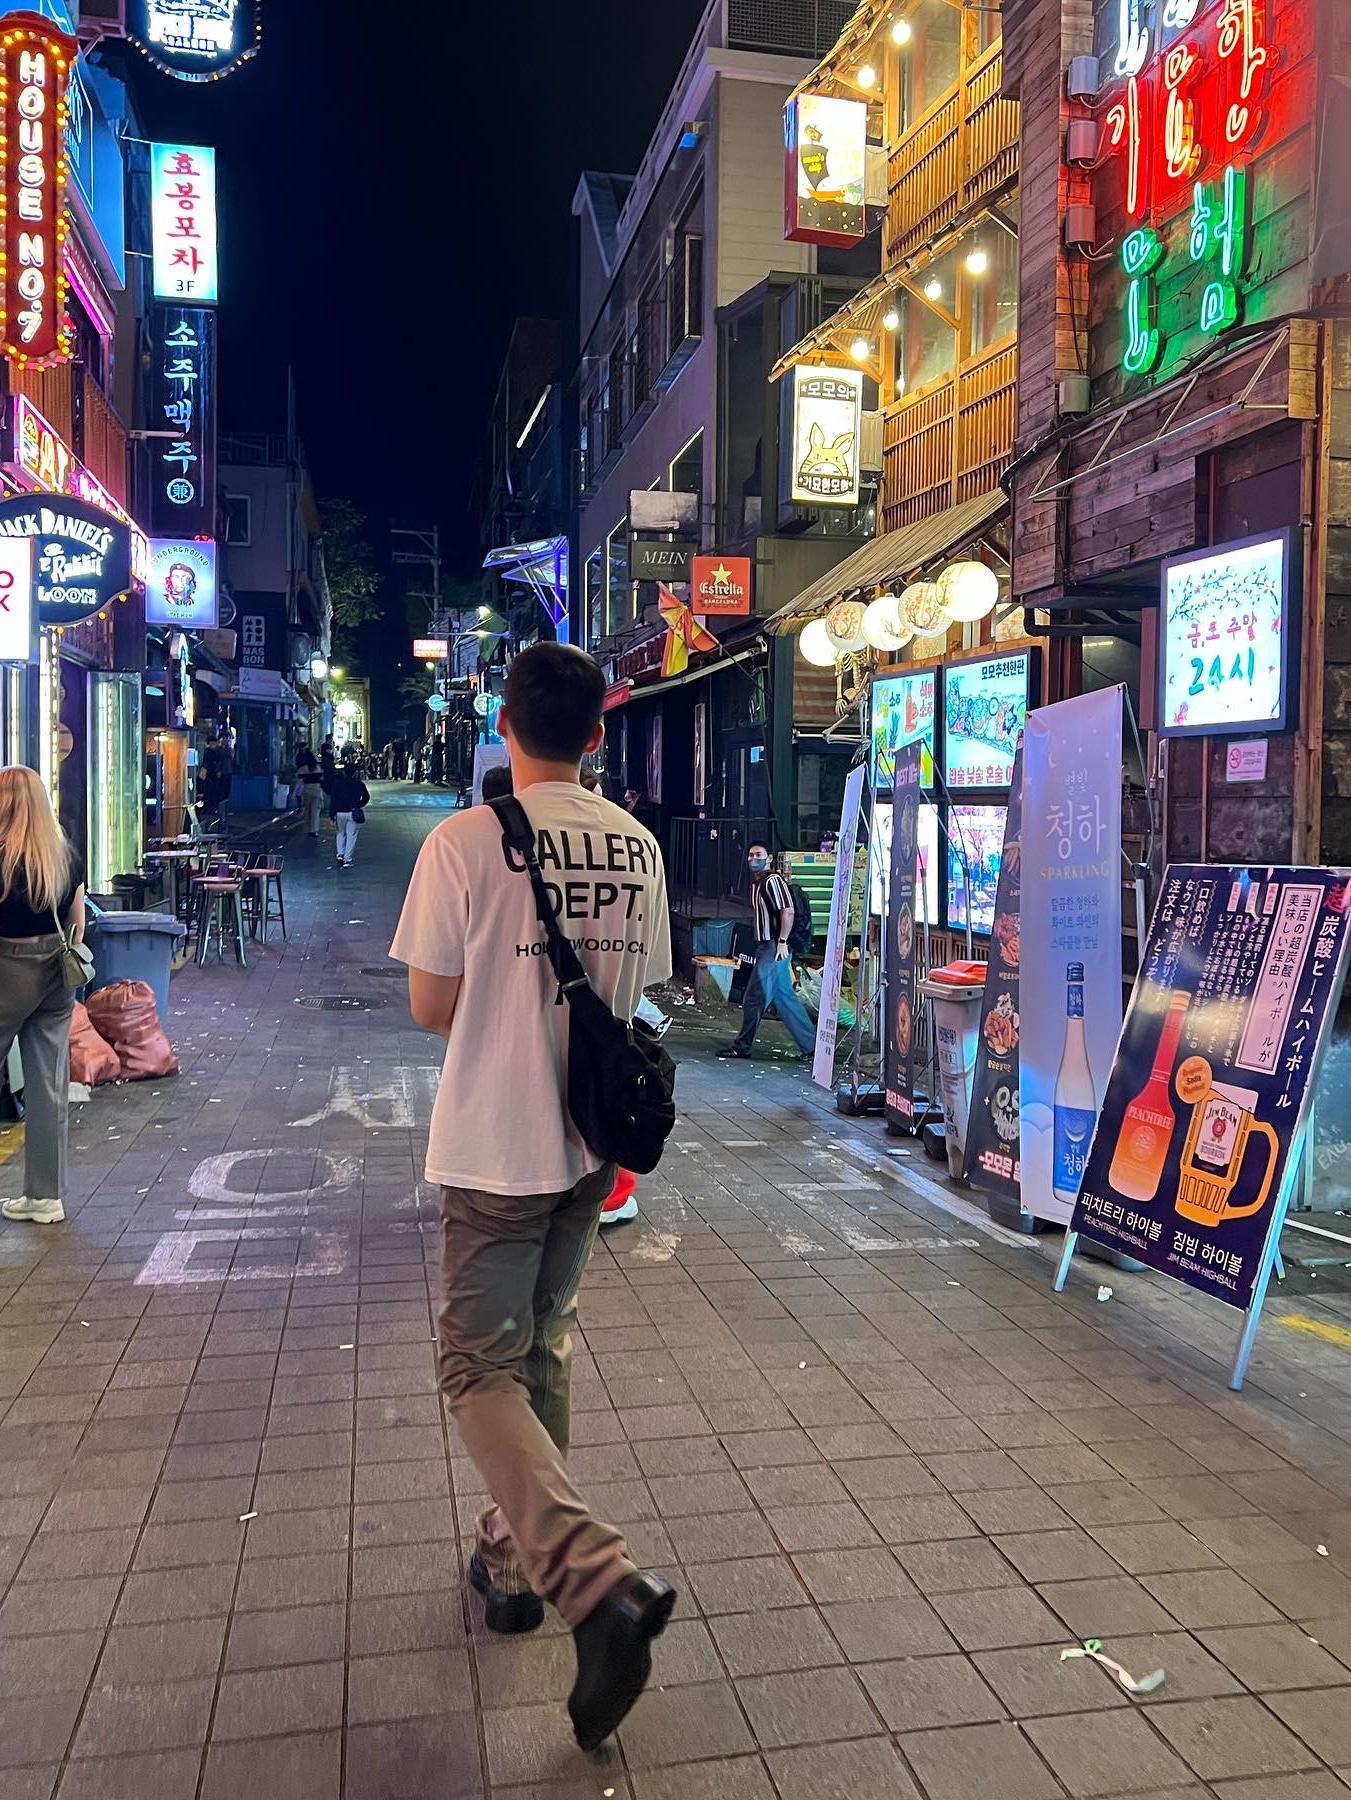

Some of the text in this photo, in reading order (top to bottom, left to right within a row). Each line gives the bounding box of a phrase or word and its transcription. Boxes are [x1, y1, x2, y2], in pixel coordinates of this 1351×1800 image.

[18, 50, 45, 221] HOUSE
[176, 280, 195, 292] 3F
[807, 381, 850, 400] 모모의
[0, 508, 114, 556] ACK DANIEL'S
[153, 546, 209, 567] UNDERGROUND
[642, 551, 688, 565] MEIN
[699, 580, 744, 596] Estrella
[1227, 610, 1257, 641] 주말
[243, 648, 265, 656] MAS
[243, 656, 265, 664] BON
[1188, 646, 1255, 696] 24시
[986, 765, 1003, 784] 혼술
[1045, 794, 1107, 859] 청하
[1040, 861, 1109, 881] SPARKLING
[536, 881, 644, 922] DEPT.
[1127, 1105, 1174, 1130] PEACHTREE
[1205, 1106, 1237, 1128] JIM BEAM
[1081, 1191, 1162, 1242] 피치트리 하이볼
[1173, 1230, 1244, 1278] 짐빔 하이볼
[1179, 1255, 1202, 1275] BEAM
[1200, 1263, 1238, 1291] HIGHBALL
